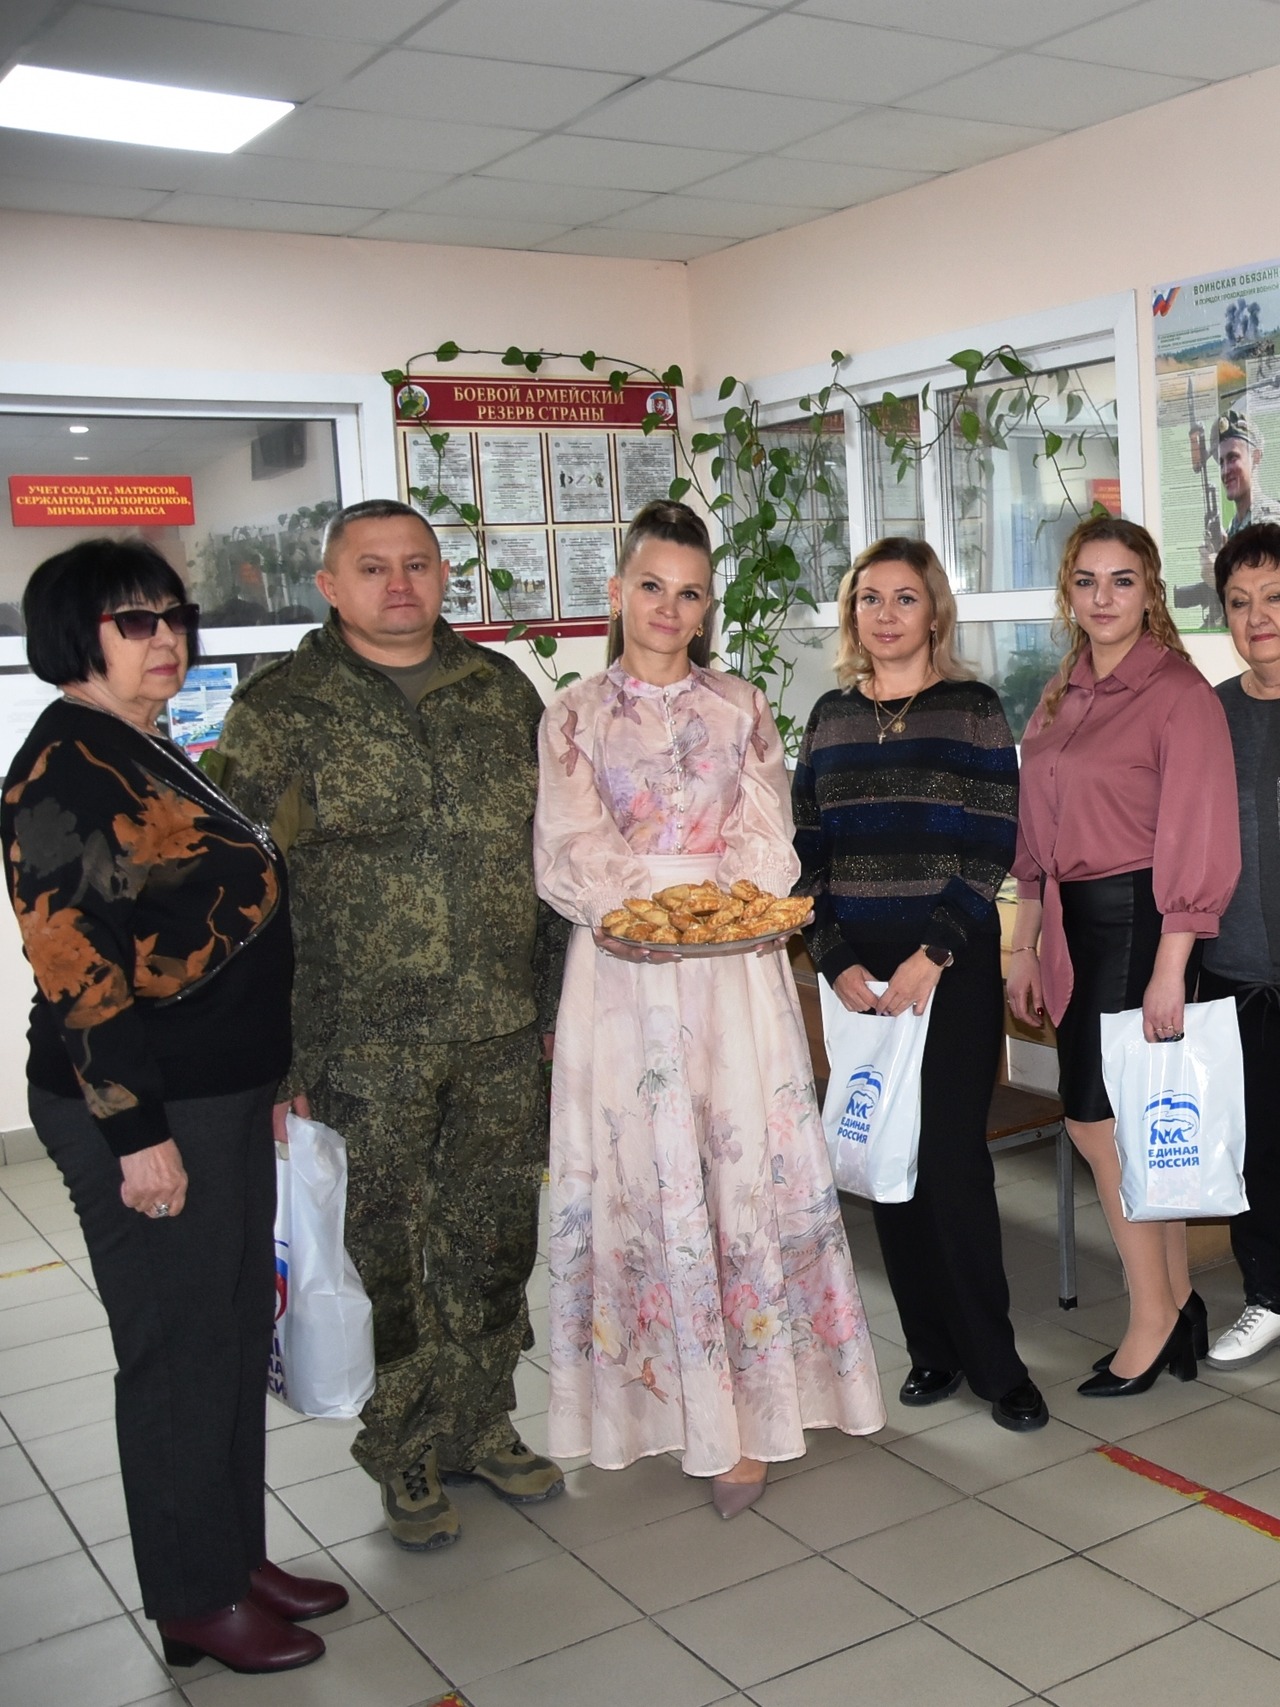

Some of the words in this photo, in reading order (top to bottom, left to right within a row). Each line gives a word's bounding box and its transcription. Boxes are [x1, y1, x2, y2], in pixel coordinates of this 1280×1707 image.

[1193, 277, 1237, 296] ВОИНСКАЯ
[453, 384, 521, 403] БОЕВОЙ
[477, 405, 535, 420] РЕЗЕРВ
[538, 406, 605, 422] СТРАНЫ
[28, 485, 60, 495] УЧЕТ
[61, 485, 112, 496] СОЛДАТ,
[114, 485, 179, 496] МАТРОСОВ,
[16, 496, 95, 506] СЕРЖАНТОВ,
[96, 496, 191, 506] ПРАПОРЩИКОВ,
[47, 506, 119, 516] МИЧМАНОВ
[120, 506, 166, 515] ЗАПАСА
[840, 1116, 871, 1133] ЕДИНАЯ
[837, 1127, 868, 1144] РОССИЯ
[1148, 1145, 1199, 1159] ЕДИНАЯ
[1148, 1156, 1200, 1169] РОССИЯ
